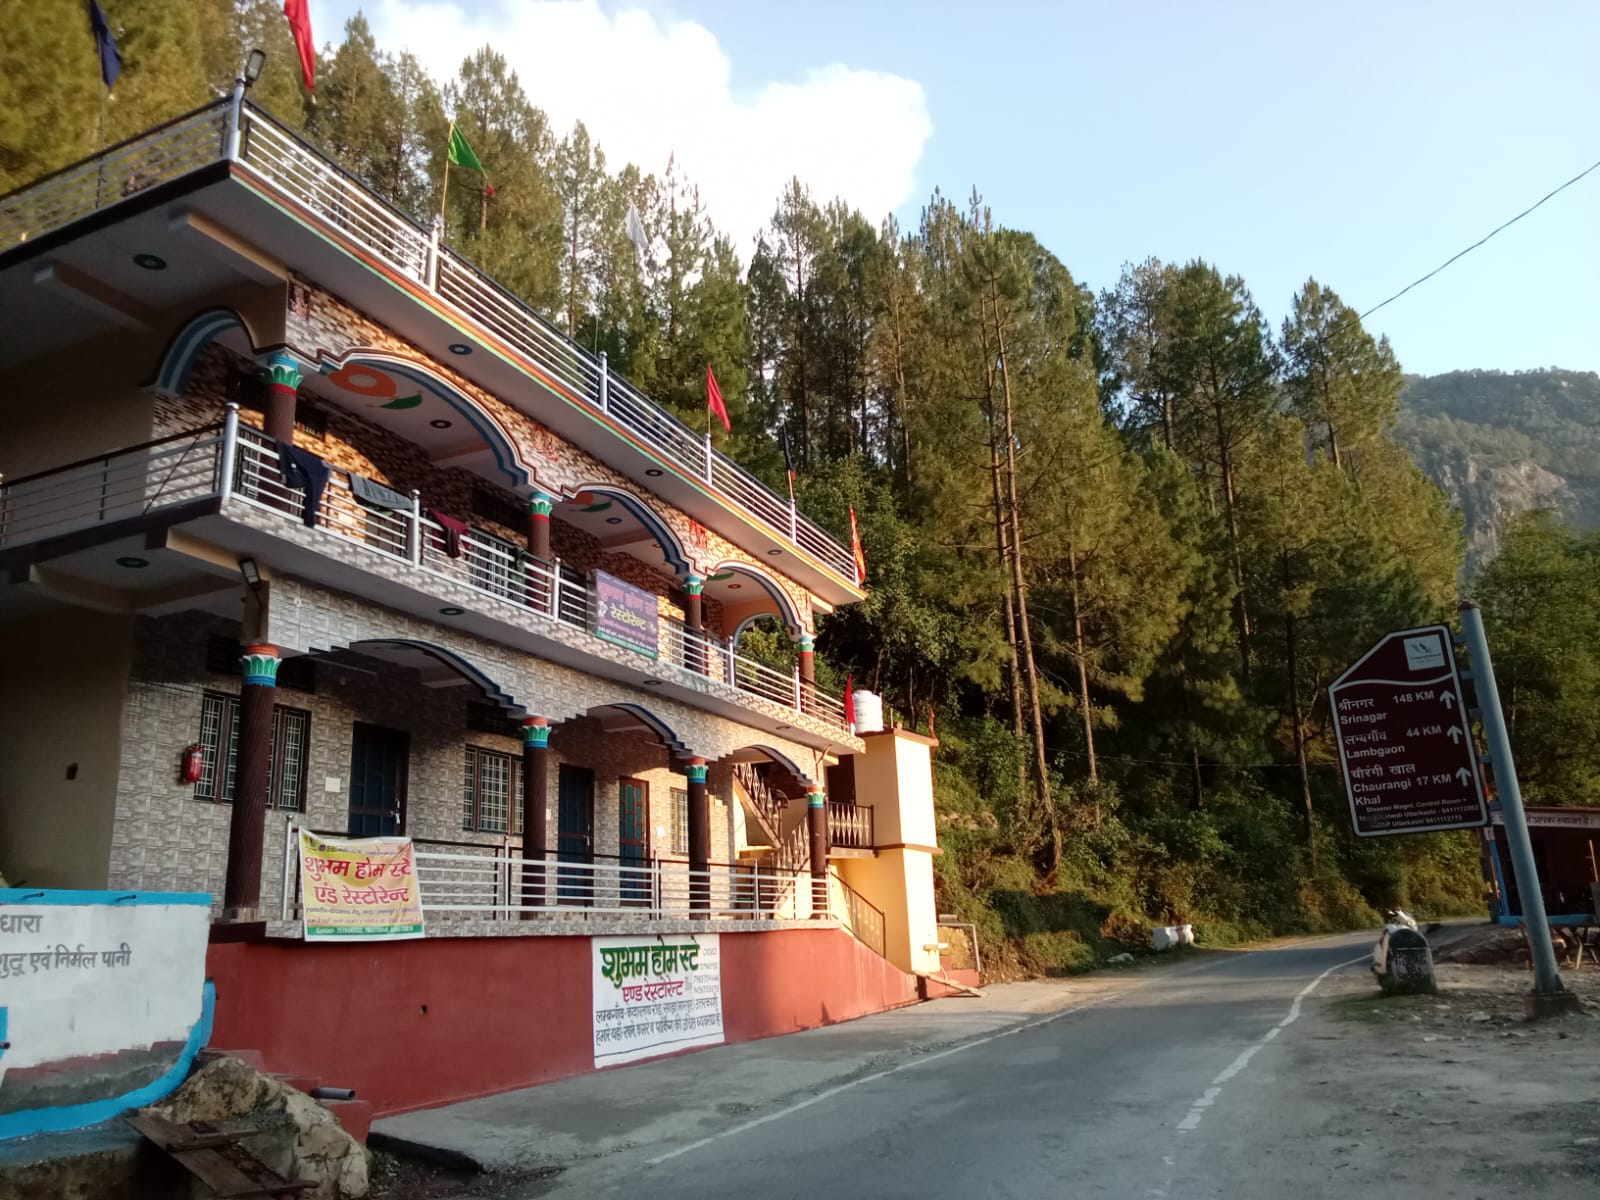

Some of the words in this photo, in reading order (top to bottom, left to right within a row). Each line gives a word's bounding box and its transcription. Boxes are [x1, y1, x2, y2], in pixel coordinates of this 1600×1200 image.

[1338, 698, 1374, 711] श्रीनगर
[1392, 693, 1413, 704] 148
[1415, 690, 1435, 701] KM
[1340, 712, 1388, 725] Srinagar
[1406, 727, 1420, 737] 44
[1423, 725, 1442, 736] KM
[1346, 745, 1406, 759] Lambgaon
[1353, 778, 1412, 793] Chaurangi
[1416, 776, 1429, 786] 17
[1432, 774, 1452, 785] KM
[1354, 794, 1381, 807] Khal
[304, 856, 352, 881] शुभम
[355, 856, 386, 880] होम
[389, 857, 412, 878] स्टे
[313, 881, 339, 905] एंड
[341, 884, 409, 905] रेस्टोरेन्ट
[29, 944, 53, 974] एवं
[54, 943, 98, 969] निर्मल
[101, 942, 133, 968] पानी
[600, 946, 651, 989] शुभम
[650, 935, 679, 977] होम
[679, 935, 700, 971] स्टे
[621, 984, 643, 1003] एण्ड
